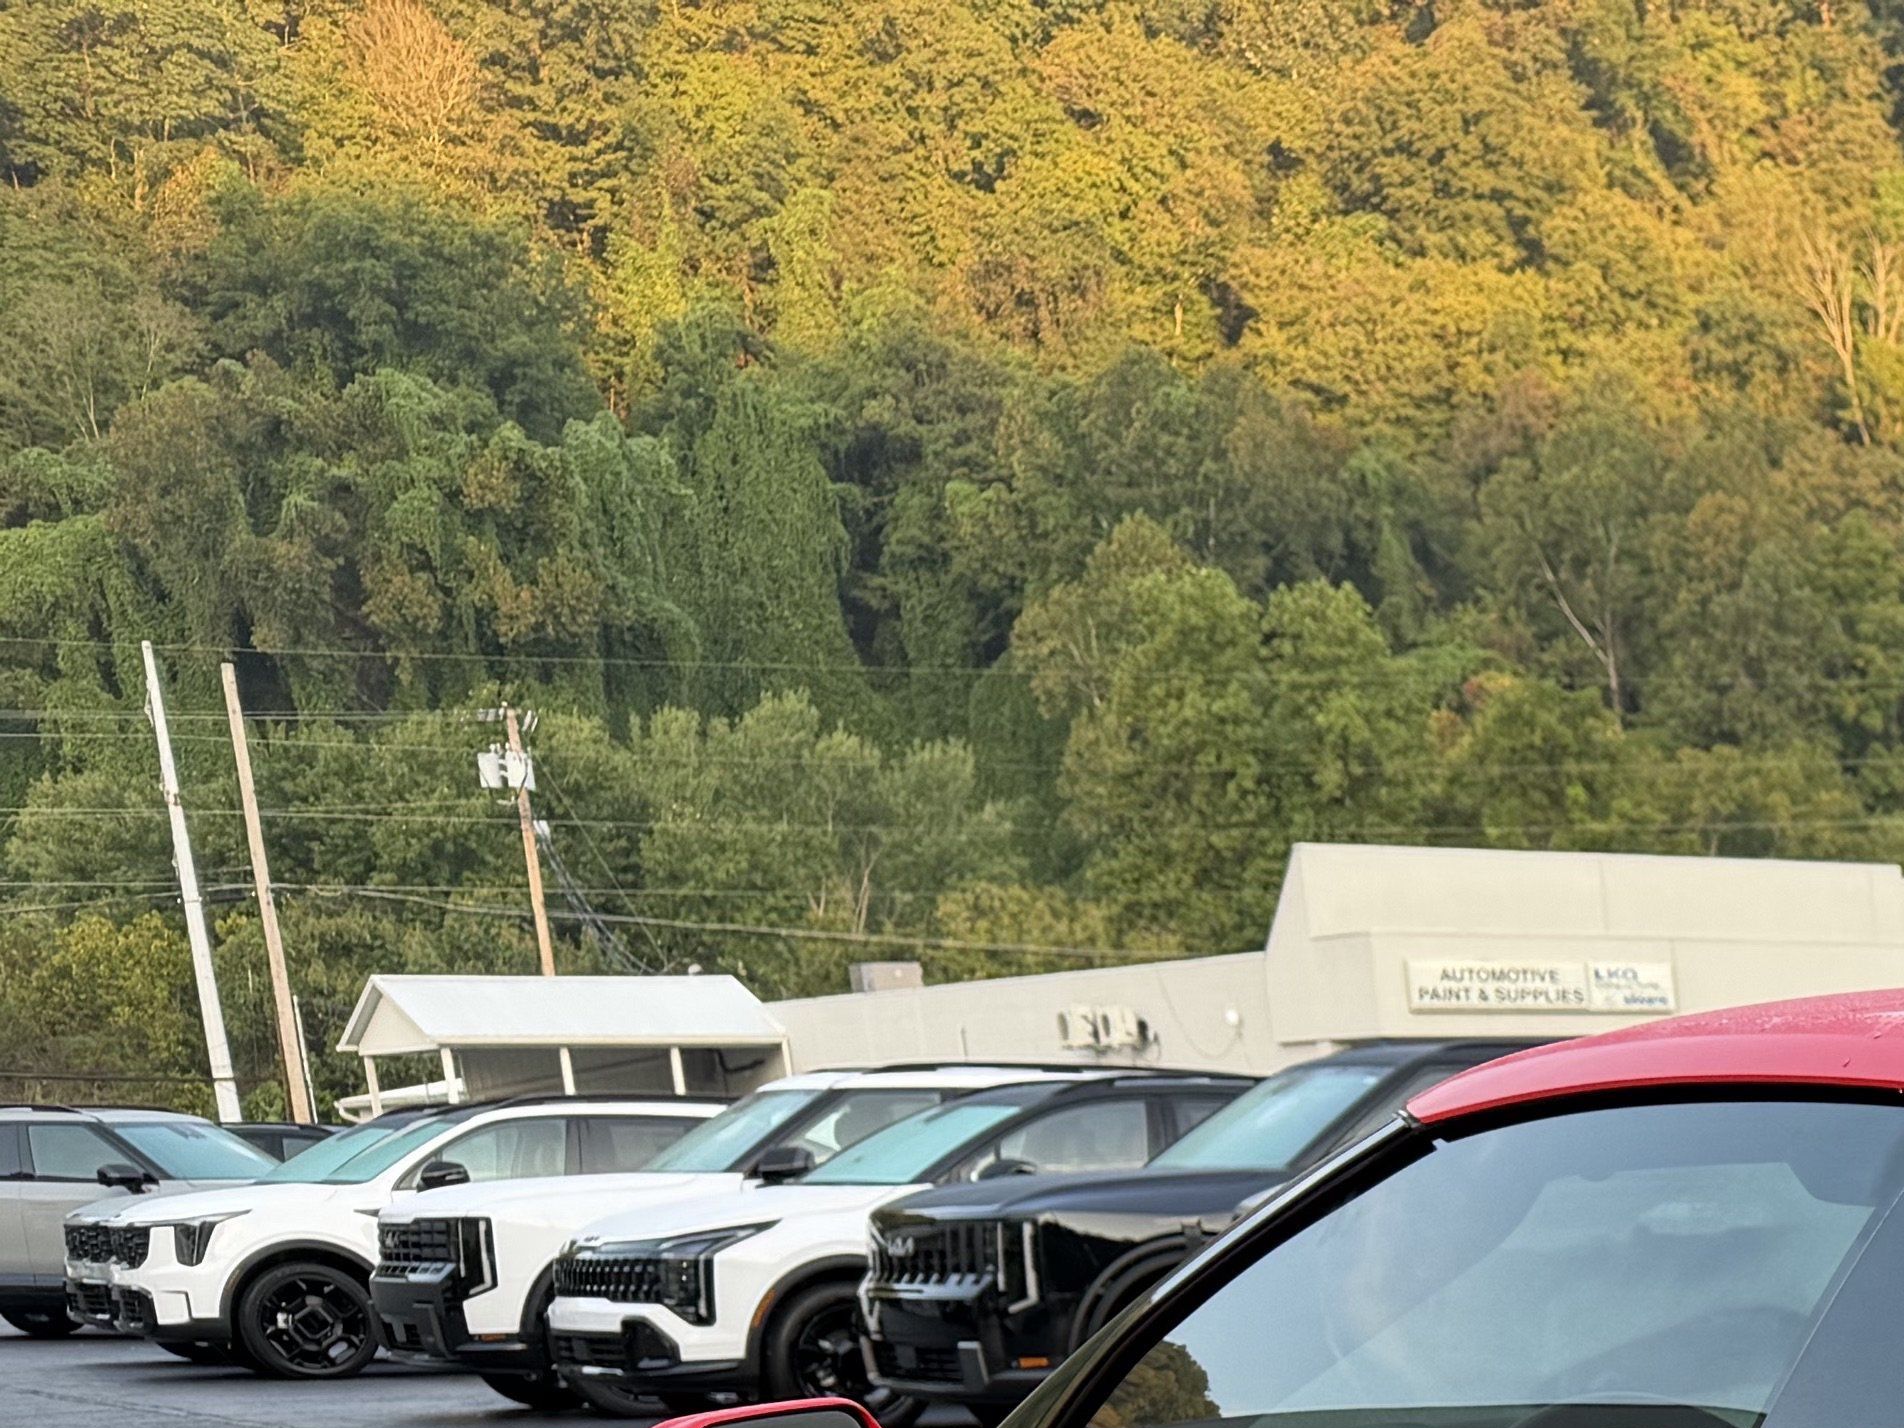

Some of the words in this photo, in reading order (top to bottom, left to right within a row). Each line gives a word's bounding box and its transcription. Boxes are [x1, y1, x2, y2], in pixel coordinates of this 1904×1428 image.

[1440, 968, 1559, 985] AUTOMOTIVE
[1418, 987, 1470, 1002] PAINT
[1478, 988, 1489, 1003] &
[1494, 988, 1585, 1005] SUPPLIES
